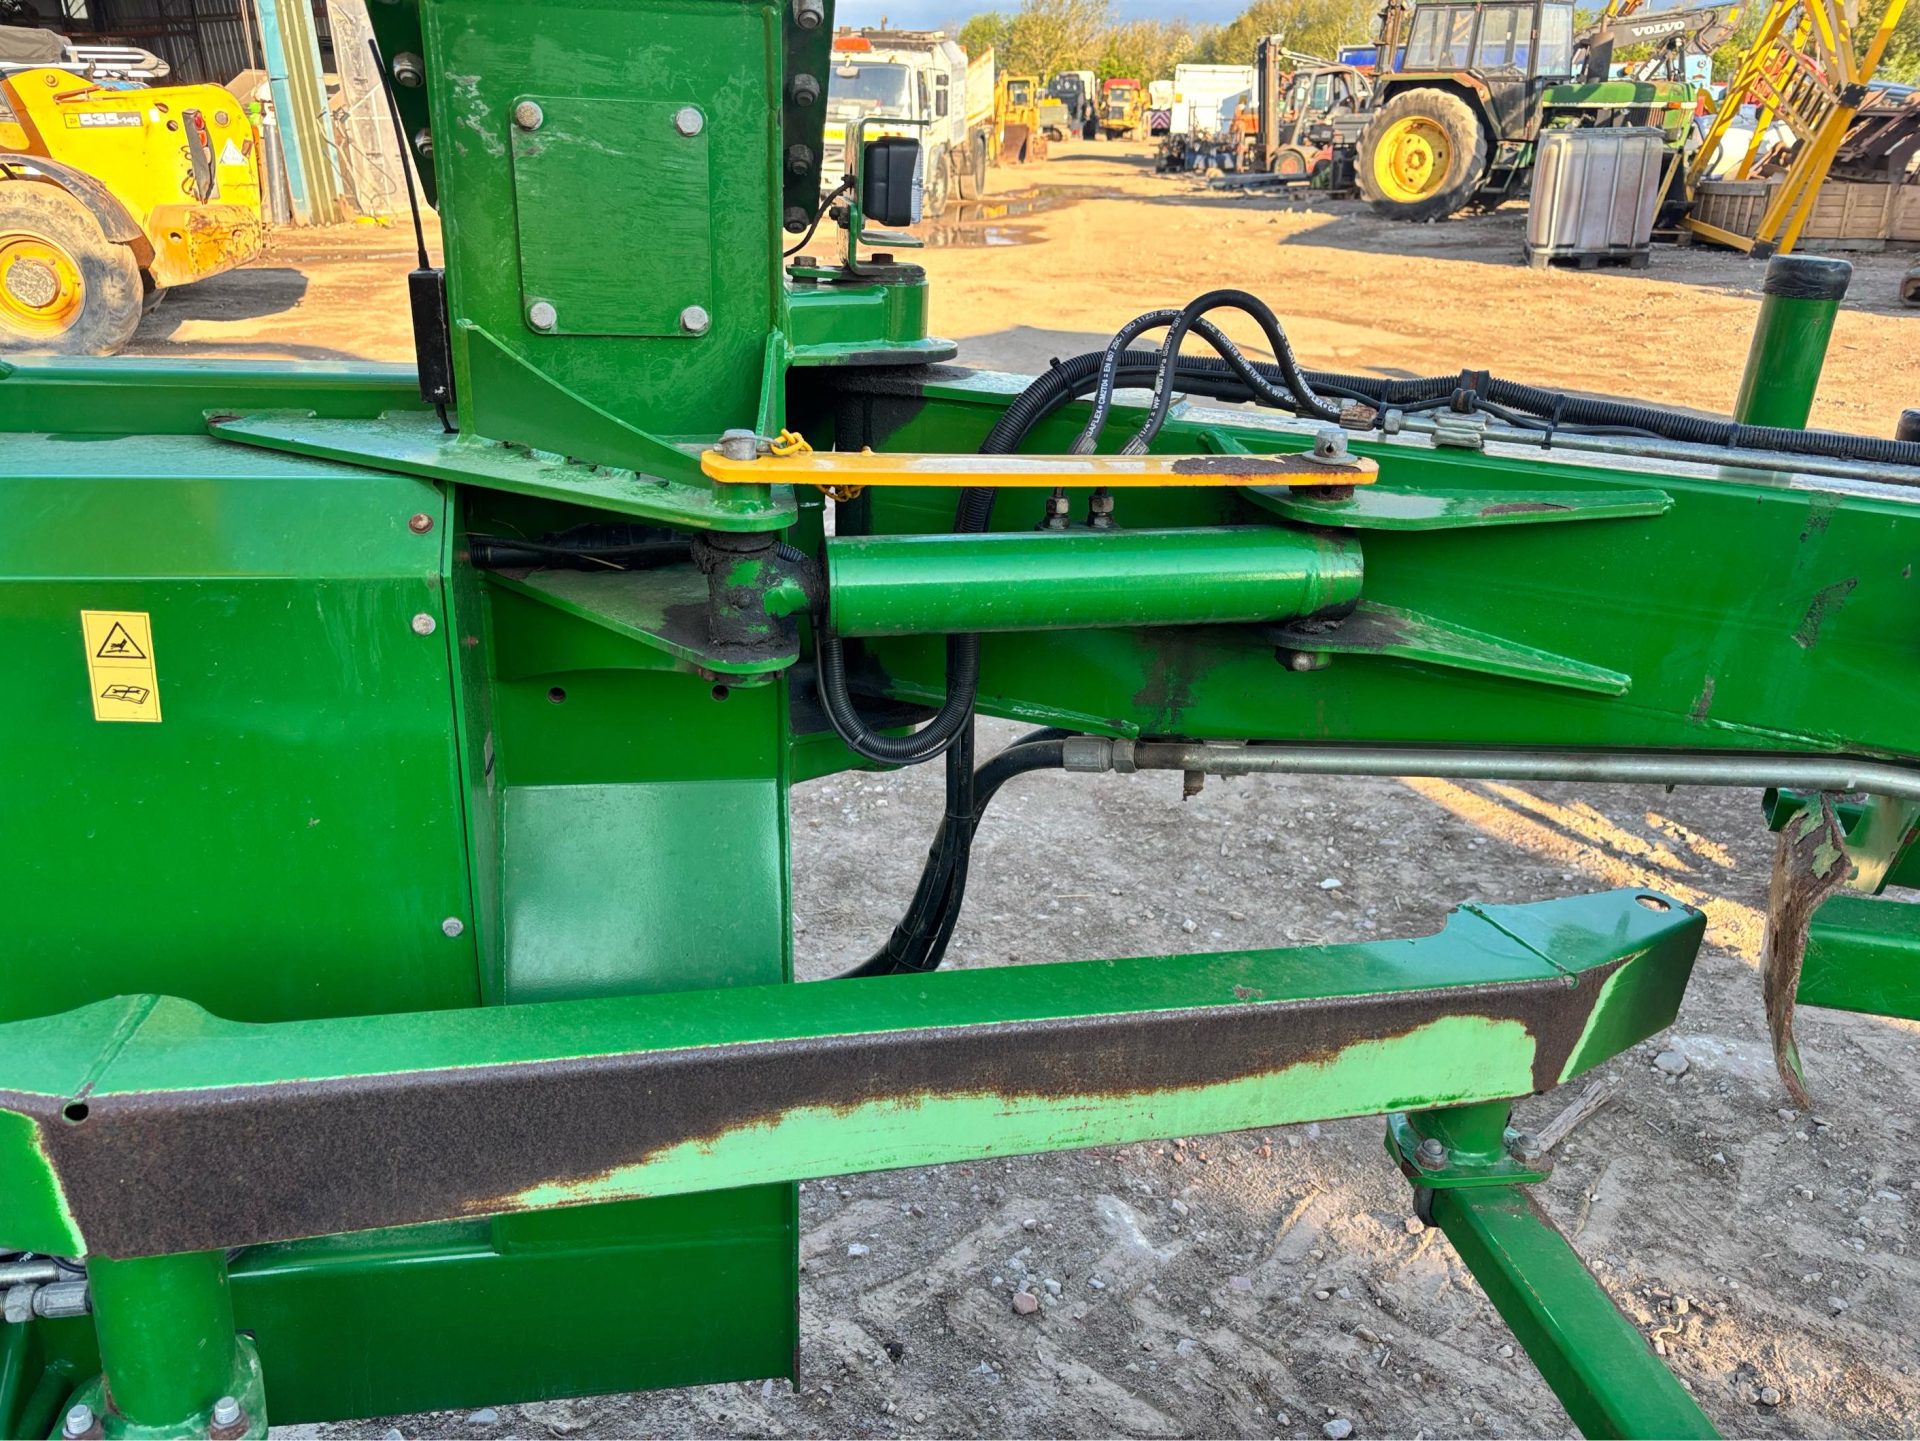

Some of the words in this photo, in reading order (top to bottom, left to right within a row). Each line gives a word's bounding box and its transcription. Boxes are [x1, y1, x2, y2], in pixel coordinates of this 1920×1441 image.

[1631, 21, 1685, 36] VOLVO
[1103, 363, 1111, 372] EN
[1112, 337, 1123, 349] 2SC
[1124, 323, 1136, 333] ISO
[1137, 311, 1158, 323] 11237
[1271, 389, 1283, 397] WP
[1297, 373, 1323, 407] MEGAFLEX
[1153, 397, 1161, 409] WP
